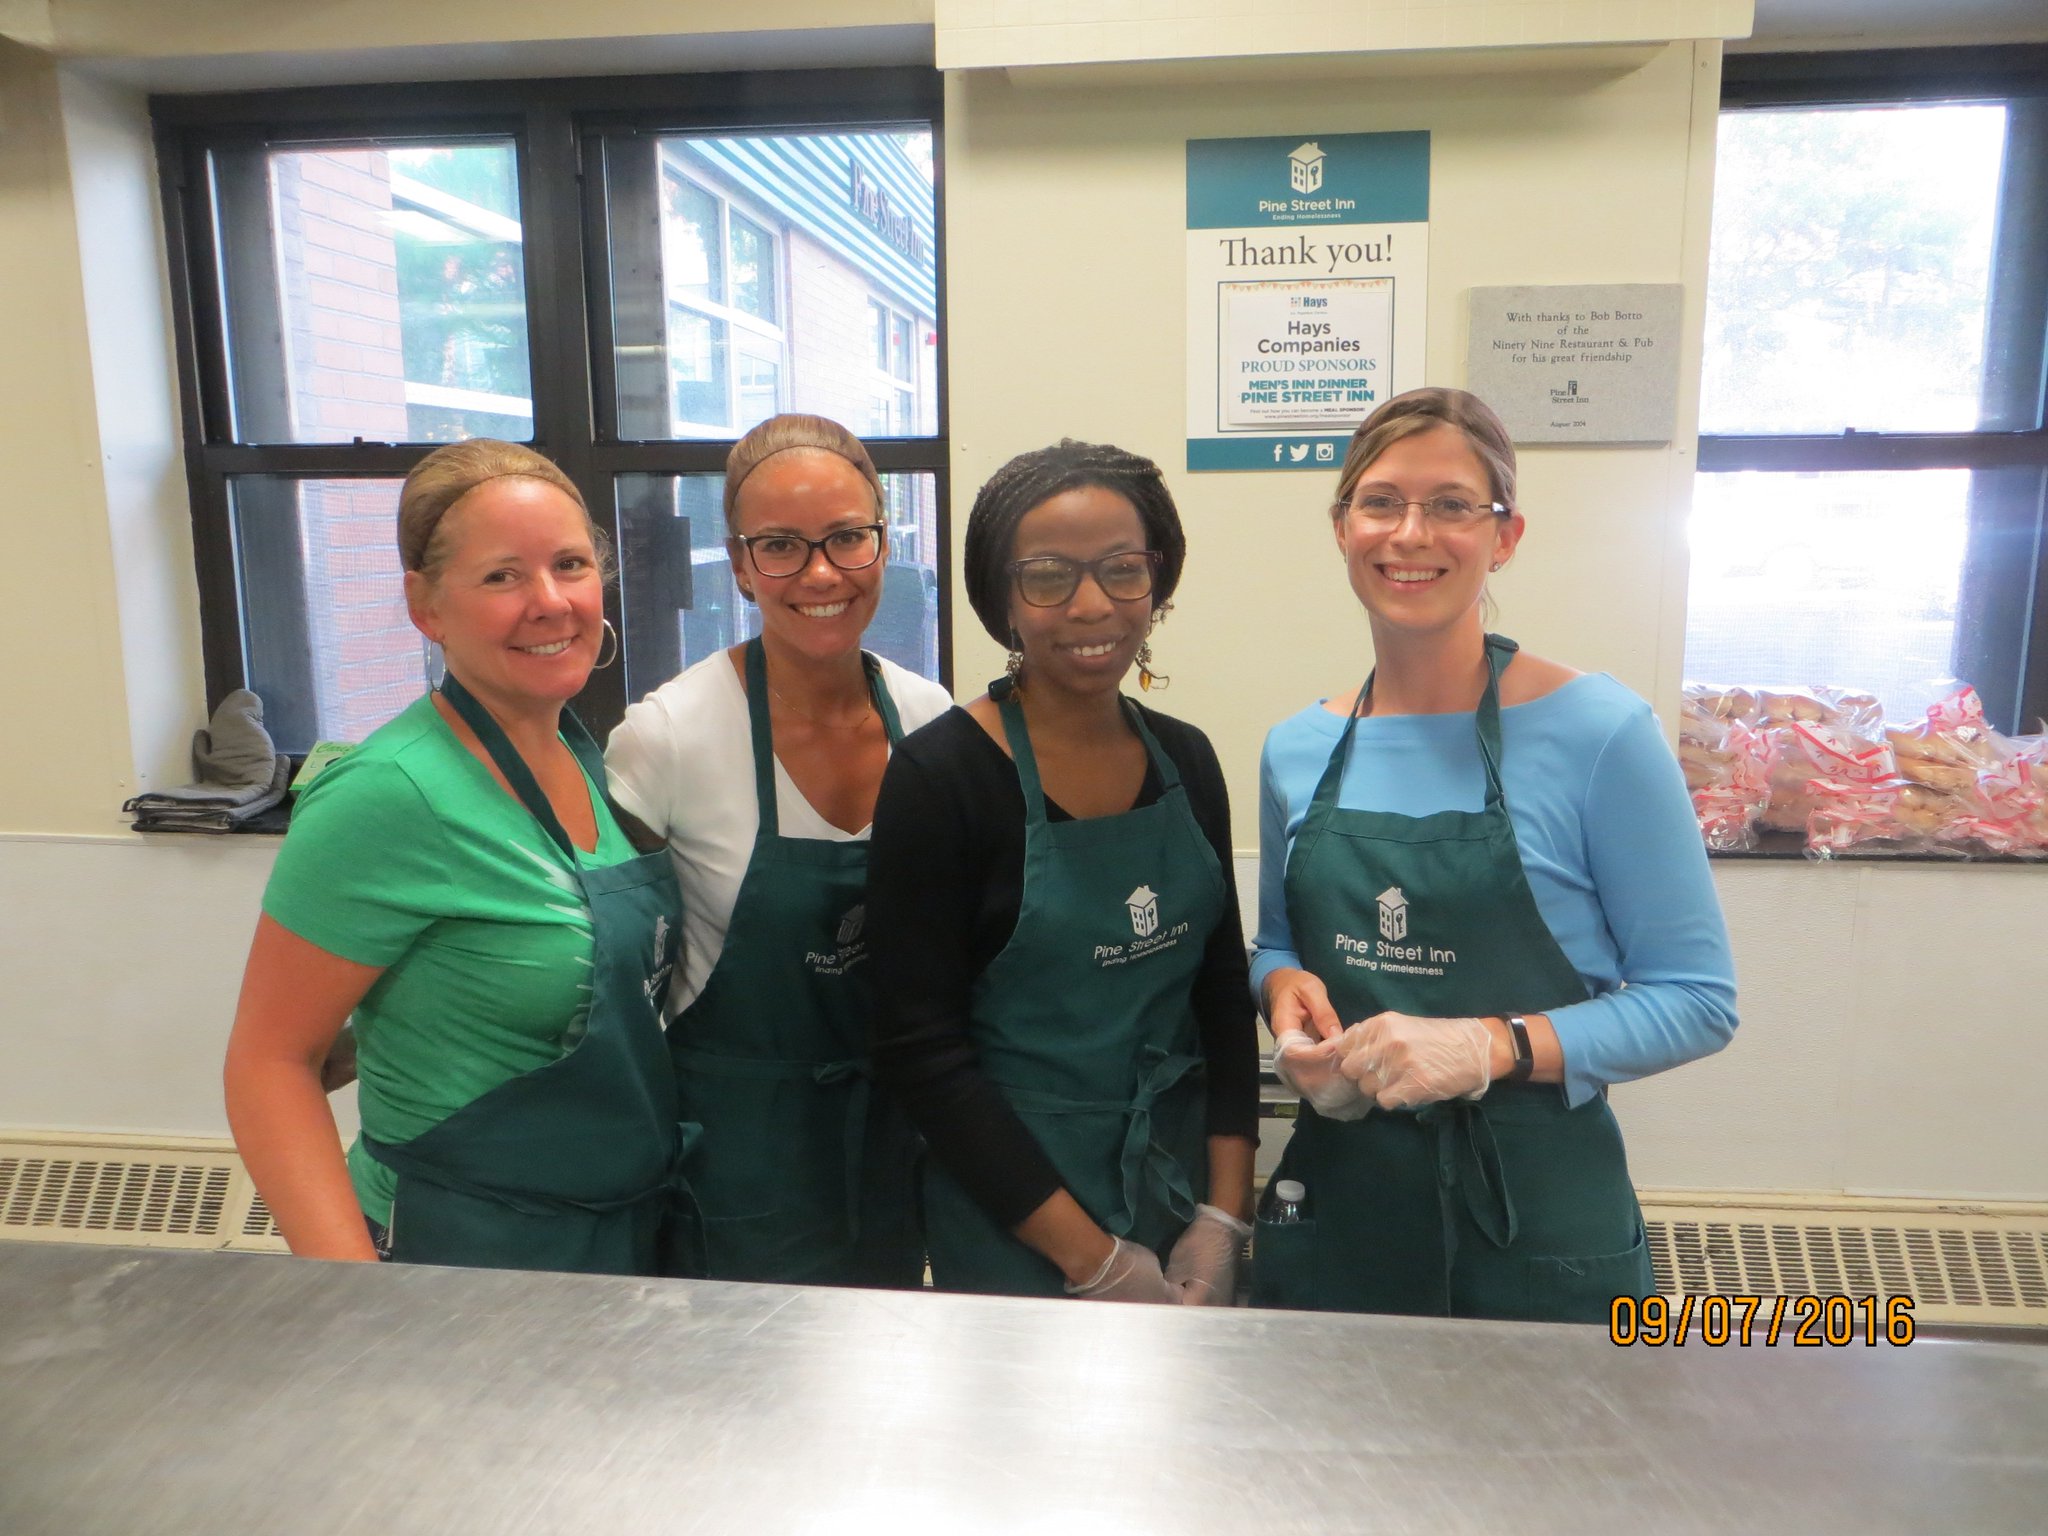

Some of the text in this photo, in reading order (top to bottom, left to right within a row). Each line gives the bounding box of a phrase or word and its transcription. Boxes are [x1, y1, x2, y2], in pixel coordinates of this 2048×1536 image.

[1258, 198, 1356, 213] Pine Street Inn
[1272, 212, 1342, 221] Ending Homelessness
[1219, 233, 1393, 274] Thank you!
[1303, 296, 1328, 308] Hays
[1506, 310, 1643, 323] With thanks to Bob Botto
[1287, 320, 1332, 337] Hays
[1557, 325, 1589, 335] of the
[1257, 337, 1361, 356] Companies
[1492, 338, 1654, 352] Ninety Nine Restaurant & Pub
[1511, 352, 1633, 365] for his great friendship
[1241, 358, 1376, 374] PROUD SPONSORS
[1248, 378, 1367, 390] MEN'S INN DINNER
[1241, 390, 1375, 404] PINE STREET INN
[1094, 922, 1188, 960] Pine Street Inn
[1335, 933, 1456, 963] Pine Street Inn
[805, 951, 837, 965] Pine
[1346, 955, 1444, 976] Ending Homelessness
